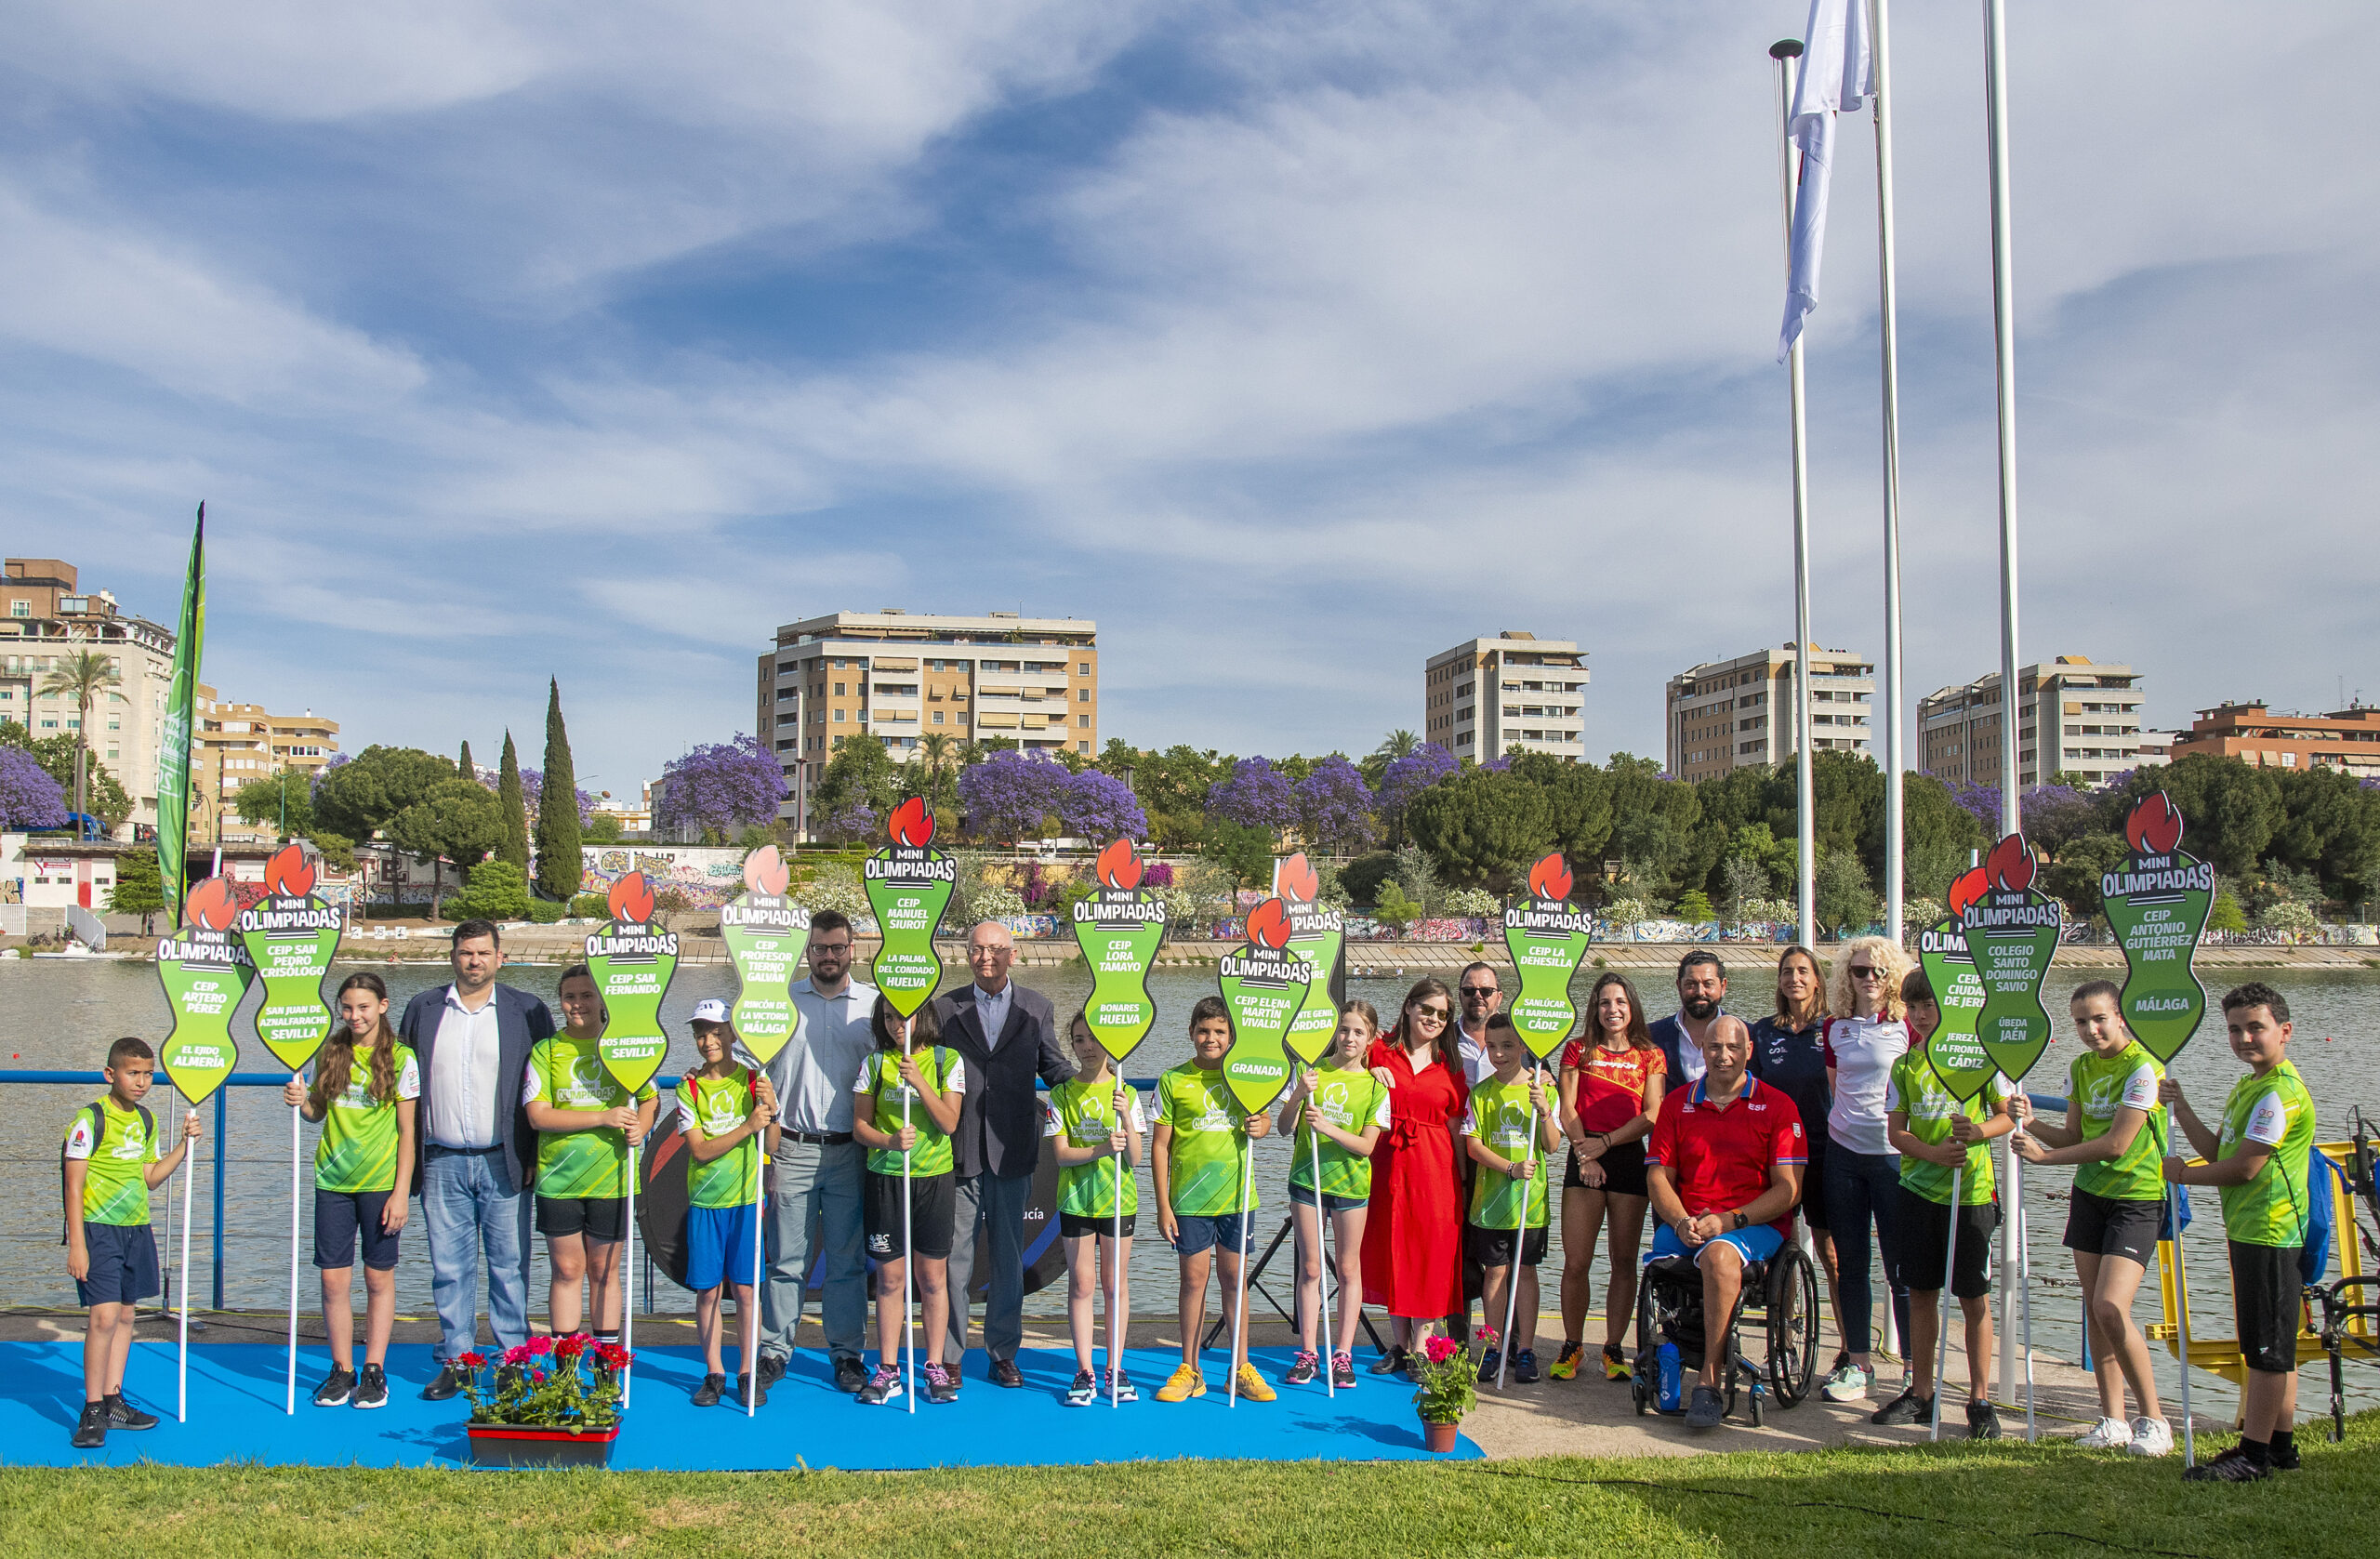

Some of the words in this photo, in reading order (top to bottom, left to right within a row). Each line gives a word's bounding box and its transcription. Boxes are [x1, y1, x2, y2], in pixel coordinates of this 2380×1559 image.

[896, 849, 923, 861] MINI
[866, 858, 955, 880] OLIMPIADAS
[2137, 856, 2170, 870] MINI
[2103, 865, 2210, 897] OLIMPIADAS
[754, 897, 780, 907] MINI
[1106, 891, 1133, 902] MINI
[1996, 894, 2024, 905] MINI
[276, 899, 306, 909] MINI
[896, 898, 920, 908] CEIP
[1289, 904, 1312, 914] MINI
[1537, 902, 1563, 912] MINI
[722, 905, 809, 930] OLIMPIADAS
[887, 908, 929, 919] MANUEL
[1074, 901, 1165, 923] OLIMPIADAS
[1964, 902, 2058, 929] OLIMPIADAS
[2143, 910, 2171, 922] CEIP
[241, 907, 341, 931] OLIMPIADAS
[889, 919, 928, 930] SIUROT
[1291, 911, 1341, 931] PIADAS
[1506, 908, 1592, 934] OLIMPIADAS
[619, 925, 646, 935] MINI
[2129, 921, 2186, 936] ANTONIO
[194, 931, 225, 944] MINI
[2125, 932, 2193, 949] GUTIÉRREZ
[267, 945, 294, 956] CEIP
[295, 945, 318, 955] SAN
[587, 933, 678, 956] OLIMPIADAS
[755, 941, 778, 950] CEIP
[1108, 940, 1132, 950] CEIP
[739, 950, 793, 962] PROFESOR
[1105, 950, 1134, 961] LORA
[1254, 949, 1280, 960] MINI
[1528, 945, 1551, 957] CEIP
[1553, 947, 1566, 957] LA
[1988, 945, 2034, 957] COLEGIO
[2142, 949, 2175, 961] MATA
[273, 956, 312, 966] PEDRO
[887, 955, 896, 963] LA
[897, 955, 927, 964] PALMA
[1520, 956, 1573, 968] DEHESILLA
[1993, 958, 2030, 969] SANTO
[260, 962, 326, 978] CRISÓLOGO
[747, 961, 786, 971] TIERNO
[878, 965, 893, 974] DEL
[894, 966, 936, 975] CONDADO
[1099, 961, 1142, 972] TAMAYO
[1221, 956, 1311, 984] OLIMPIADAS
[609, 974, 634, 984] CEIP
[635, 973, 656, 984] SAN
[747, 970, 786, 983] GALVÁN
[1986, 970, 2038, 981] DOMINGO
[192, 981, 219, 992] CEIP
[886, 976, 927, 988] HUELVA
[1995, 981, 2029, 992] SAVIO
[605, 984, 661, 995] FERNANDO
[1948, 984, 1986, 996] CIUDA
[181, 991, 227, 1004] ARTERO
[1235, 995, 1259, 1007] CEIP
[1259, 997, 1291, 1010] ELENA
[1524, 997, 1566, 1009] SANLÚCAR
[1943, 996, 1960, 1006] DE
[1960, 997, 1986, 1009] JERE
[186, 1001, 222, 1014] PÉREZ
[744, 998, 774, 1010] RINCÓN
[775, 1001, 787, 1010] DE
[1100, 1004, 1140, 1013] BONARES
[2135, 997, 2189, 1011] MÁLAGA
[265, 1007, 284, 1016] SAN
[284, 1006, 311, 1016] JUAN
[311, 1005, 323, 1014] DE
[740, 1011, 751, 1020] LA
[752, 1011, 789, 1021] VICTORIA
[1241, 1006, 1282, 1020] MARTÍN
[1297, 1011, 1312, 1020] NTE
[1312, 1009, 1334, 1018] GENIL
[1514, 1009, 1526, 1017] DE
[1526, 1010, 1574, 1020] BARRAMEDA
[259, 1015, 328, 1027] AZNALFARACHE
[1099, 1013, 1141, 1025] HUELVA
[1241, 1017, 1281, 1030] VIVALDI
[1289, 1018, 1333, 1032] ÓRDOBA
[1527, 1019, 1559, 1031] CÁDIZ
[1998, 1016, 2028, 1027] ÚBEDA
[271, 1028, 318, 1040] SEVILLA
[743, 1021, 787, 1035] MÁLAGA
[2000, 1027, 2027, 1041] JAÉN
[601, 1037, 618, 1047] DOS
[619, 1036, 666, 1047] HERMANAS
[1946, 1033, 1973, 1042] JEREZ
[181, 1046, 193, 1054] EL
[193, 1046, 219, 1055] EJIDO
[612, 1047, 655, 1059] SEVILLA
[1936, 1043, 1948, 1052] LA
[1949, 1044, 1987, 1055] FRONTE
[173, 1054, 225, 1068] ALMERÍA
[1947, 1054, 1984, 1069] CÁDIZ
[1232, 1063, 1283, 1077] GRANADA
[559, 1086, 615, 1102] OLIMPIADAS
